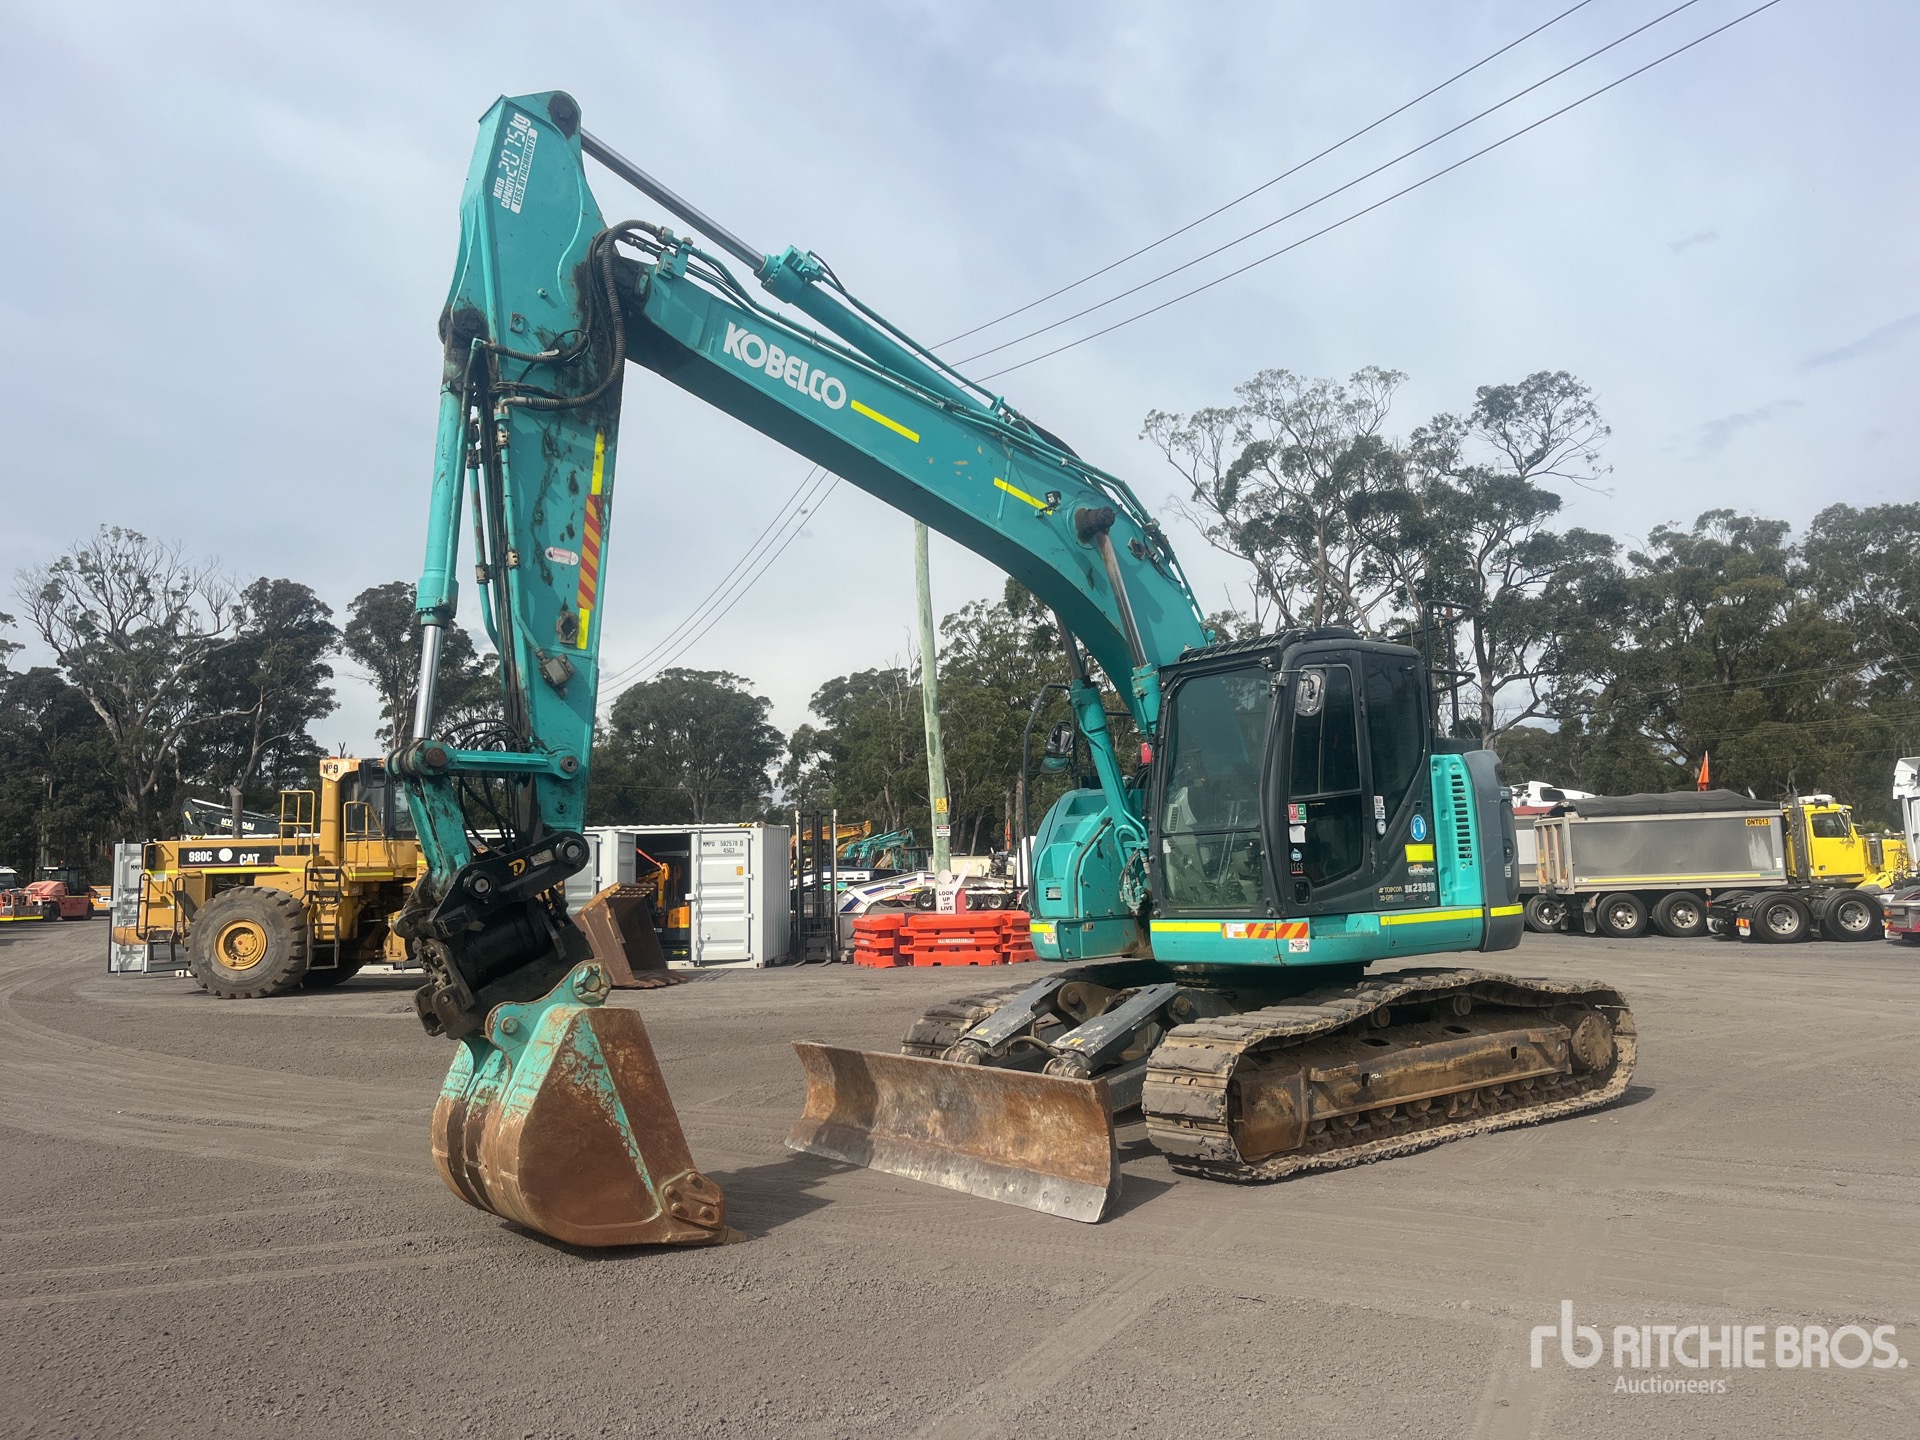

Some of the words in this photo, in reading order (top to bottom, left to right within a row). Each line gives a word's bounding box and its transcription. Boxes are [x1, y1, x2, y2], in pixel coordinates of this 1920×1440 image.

[518, 135, 536, 188] ATTACHMENTS
[493, 177, 505, 199] RATED
[501, 175, 516, 209] CAPACITY
[513, 186, 525, 206] LESS
[723, 321, 846, 410] KOBELCO
[221, 817, 255, 831] HYDAI
[188, 850, 213, 863] 980C
[239, 853, 260, 866] CAT
